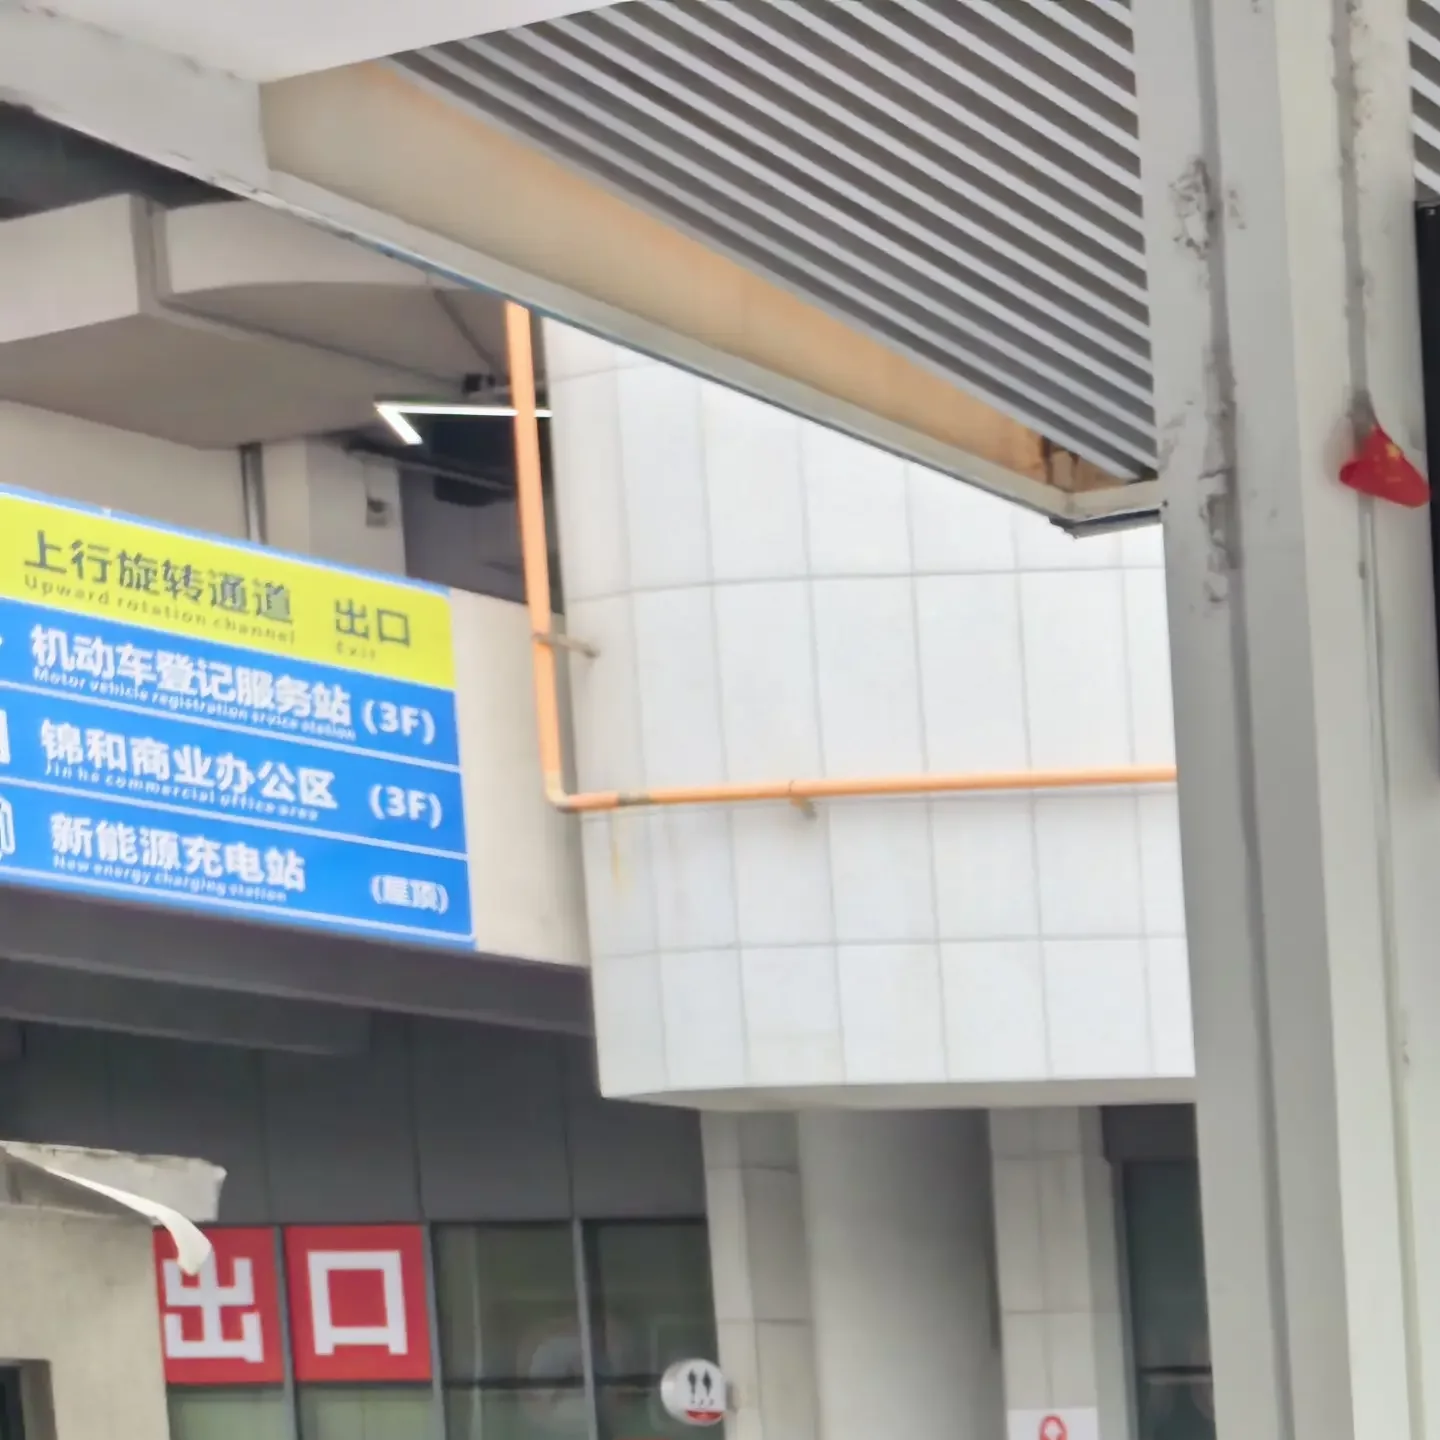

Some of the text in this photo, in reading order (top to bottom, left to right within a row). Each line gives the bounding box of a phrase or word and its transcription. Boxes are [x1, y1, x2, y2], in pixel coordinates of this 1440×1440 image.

[24, 530, 411, 649] 上行旋转通道 出口
[24, 573, 295, 645] Upward rotation channel
[30, 624, 352, 727] 机动车登记服务站
[33, 665, 86, 690] Motor
[89, 679, 149, 702] vehicle
[40, 718, 338, 809] 锦和商业办公区
[105, 774, 215, 805] commercial
[50, 812, 306, 893] 新能源充电站
[162, 1249, 409, 1363] 出口
